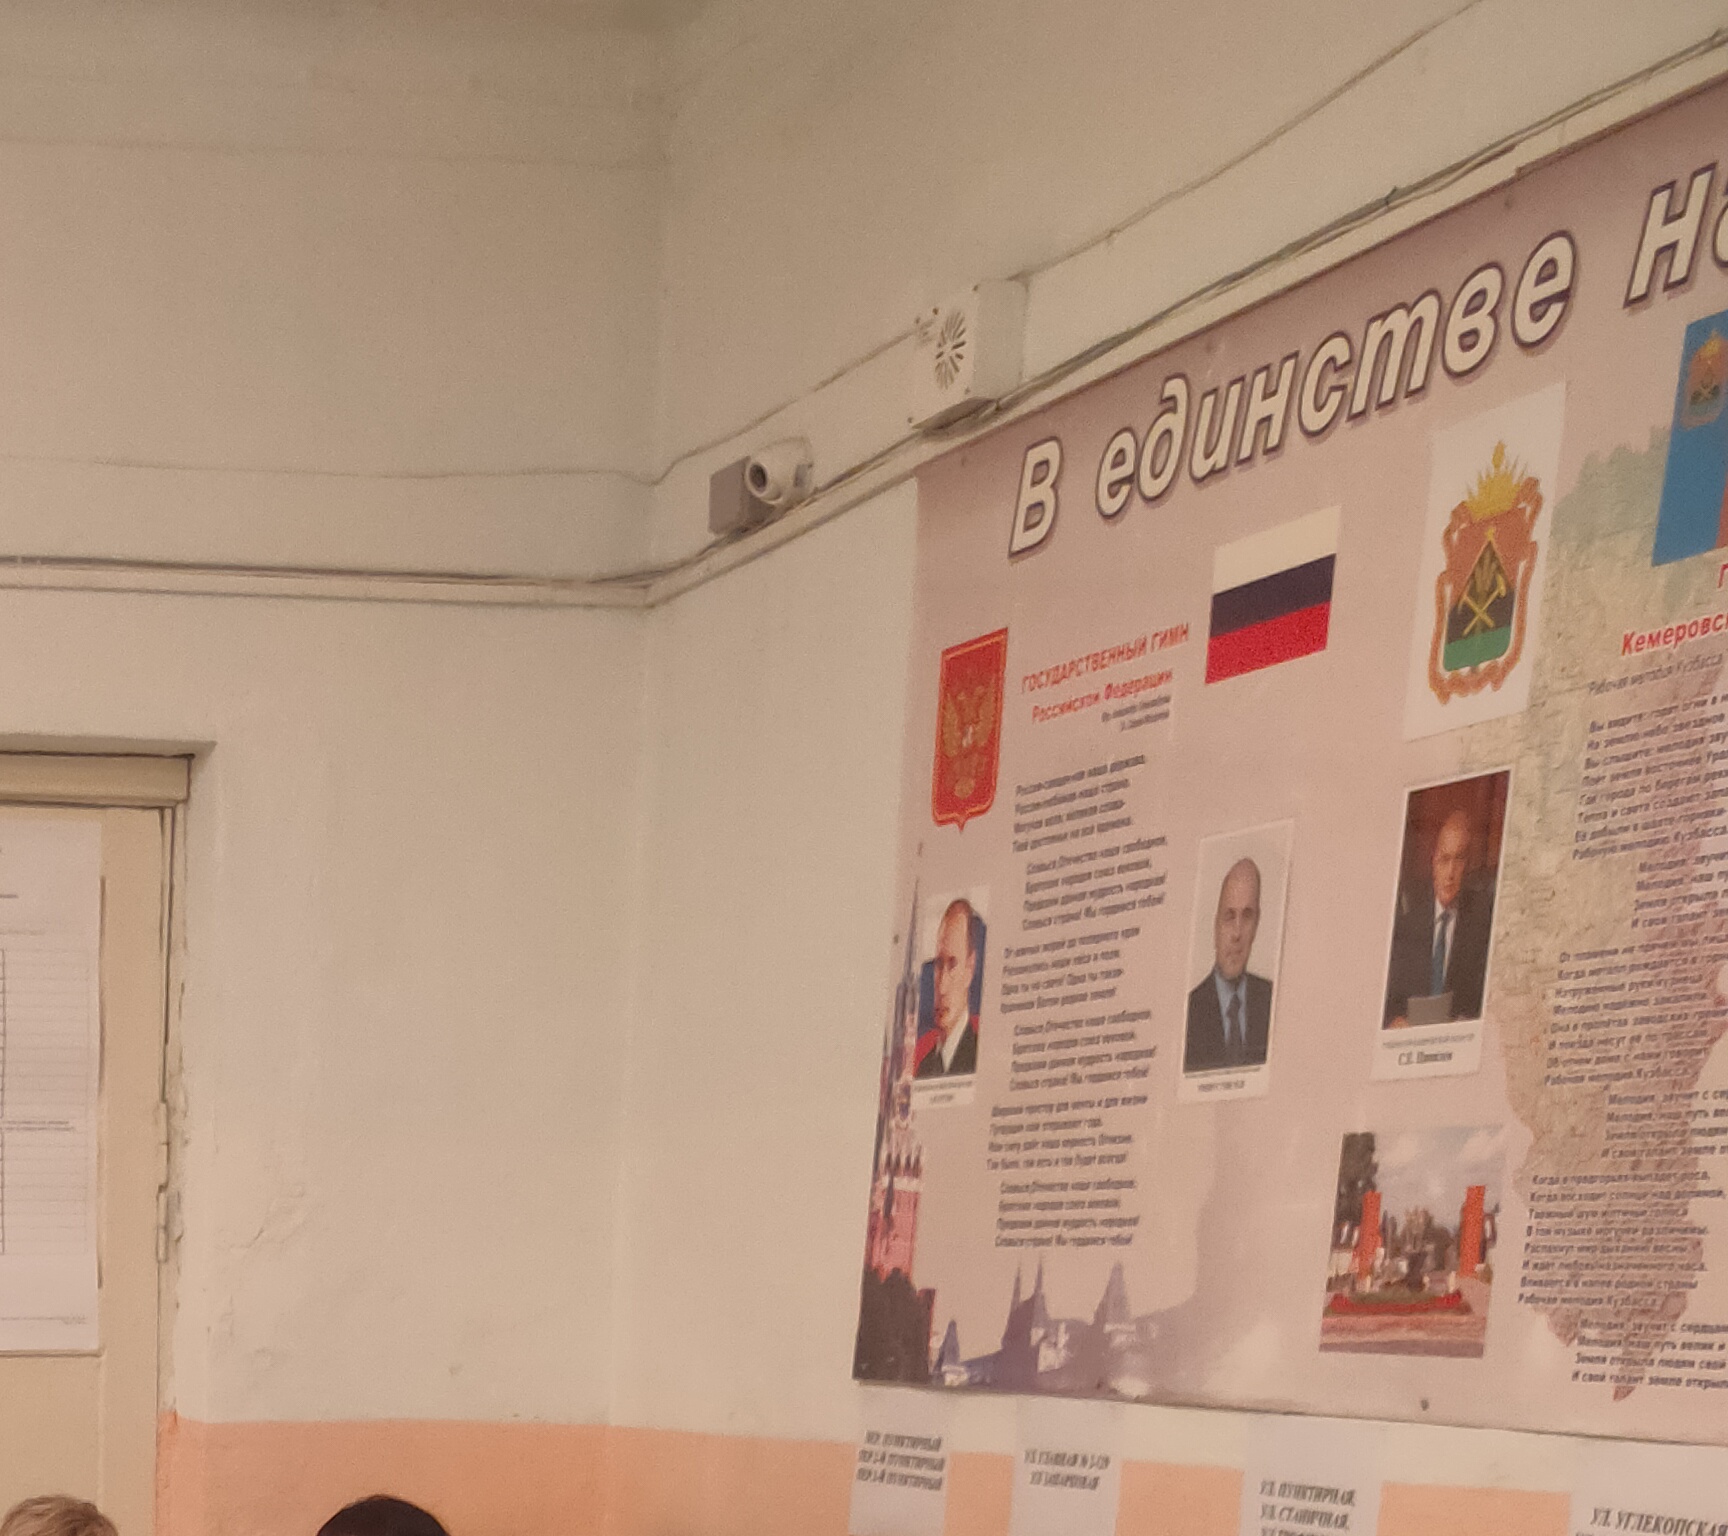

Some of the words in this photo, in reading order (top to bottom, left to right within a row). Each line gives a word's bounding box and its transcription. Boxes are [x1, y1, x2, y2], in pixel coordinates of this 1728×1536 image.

[1009, 436, 1065, 560] В
[1096, 229, 1578, 516] единстве
[1623, 161, 1728, 309] Н
[1022, 634, 1148, 692] ГОСУДАРСТВЕННЫЙ
[1150, 622, 1189, 651] ГИМН
[1032, 692, 1100, 723] Российской
[1104, 668, 1173, 700] Федерации
